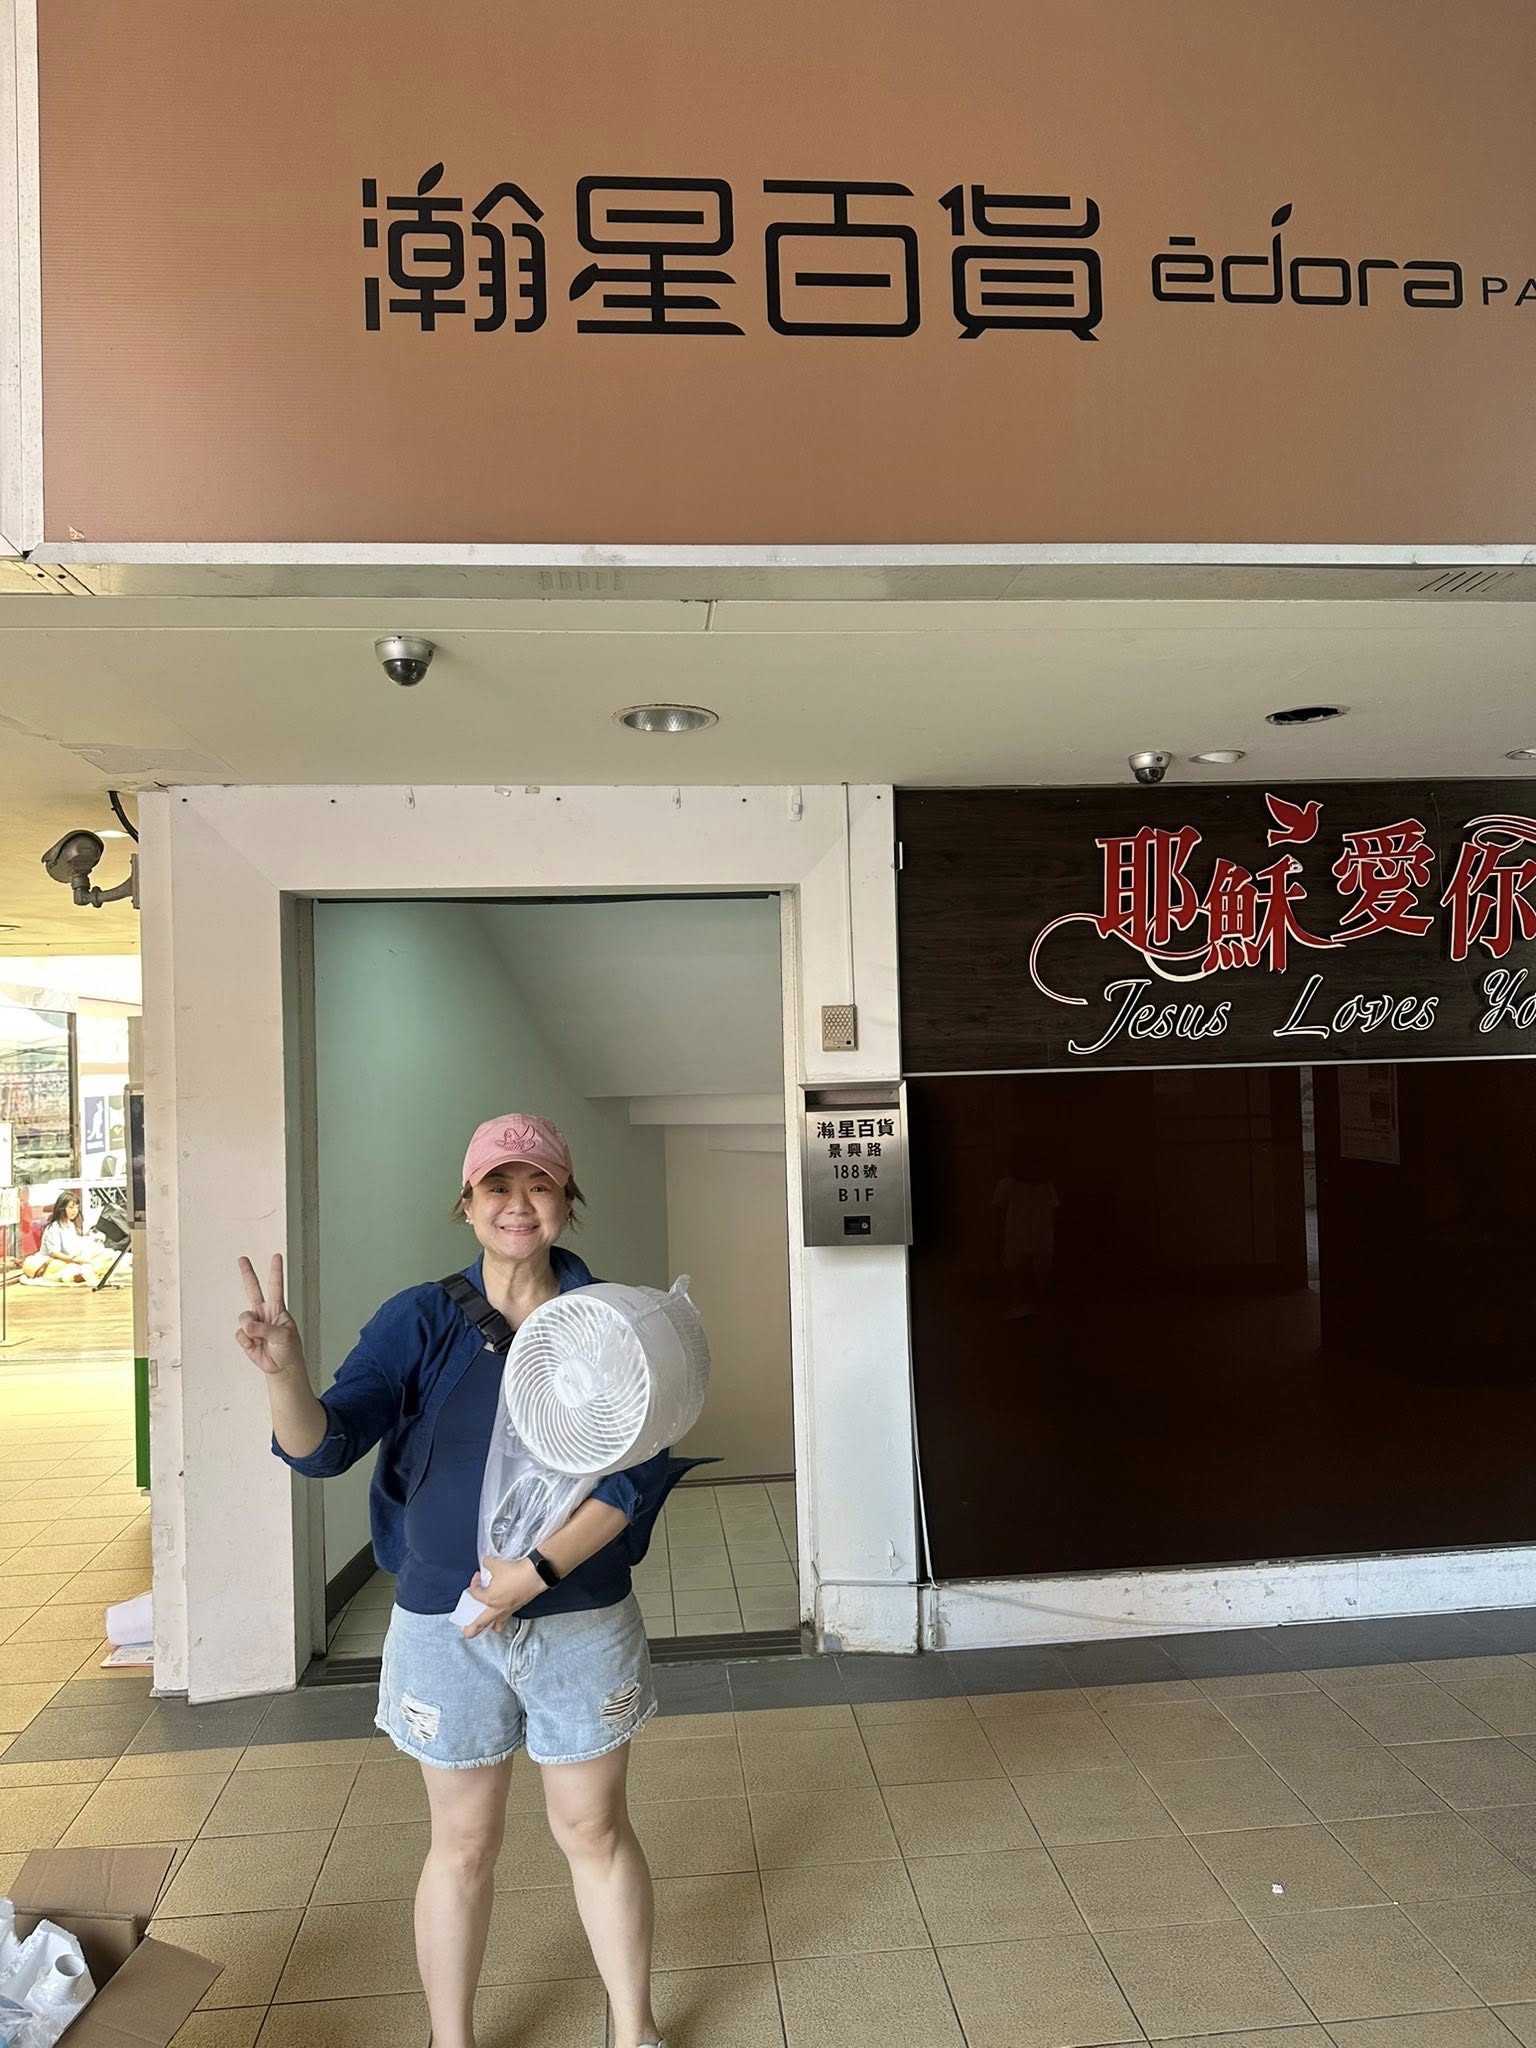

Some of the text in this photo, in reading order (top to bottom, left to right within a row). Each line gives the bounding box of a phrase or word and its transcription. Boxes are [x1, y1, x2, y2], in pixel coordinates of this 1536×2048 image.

[361, 161, 1104, 342] 瀚星百貨
[1481, 276, 1536, 307] PA
[1094, 816, 1536, 974] 耶穌愛你
[1067, 977, 1232, 1056] Jesus
[1272, 973, 1440, 1040] Loves
[816, 1118, 895, 1139] 瀚星百貨
[827, 1142, 882, 1158] 景興路
[833, 1164, 878, 1179] 188號
[838, 1188, 874, 1202] B1F
